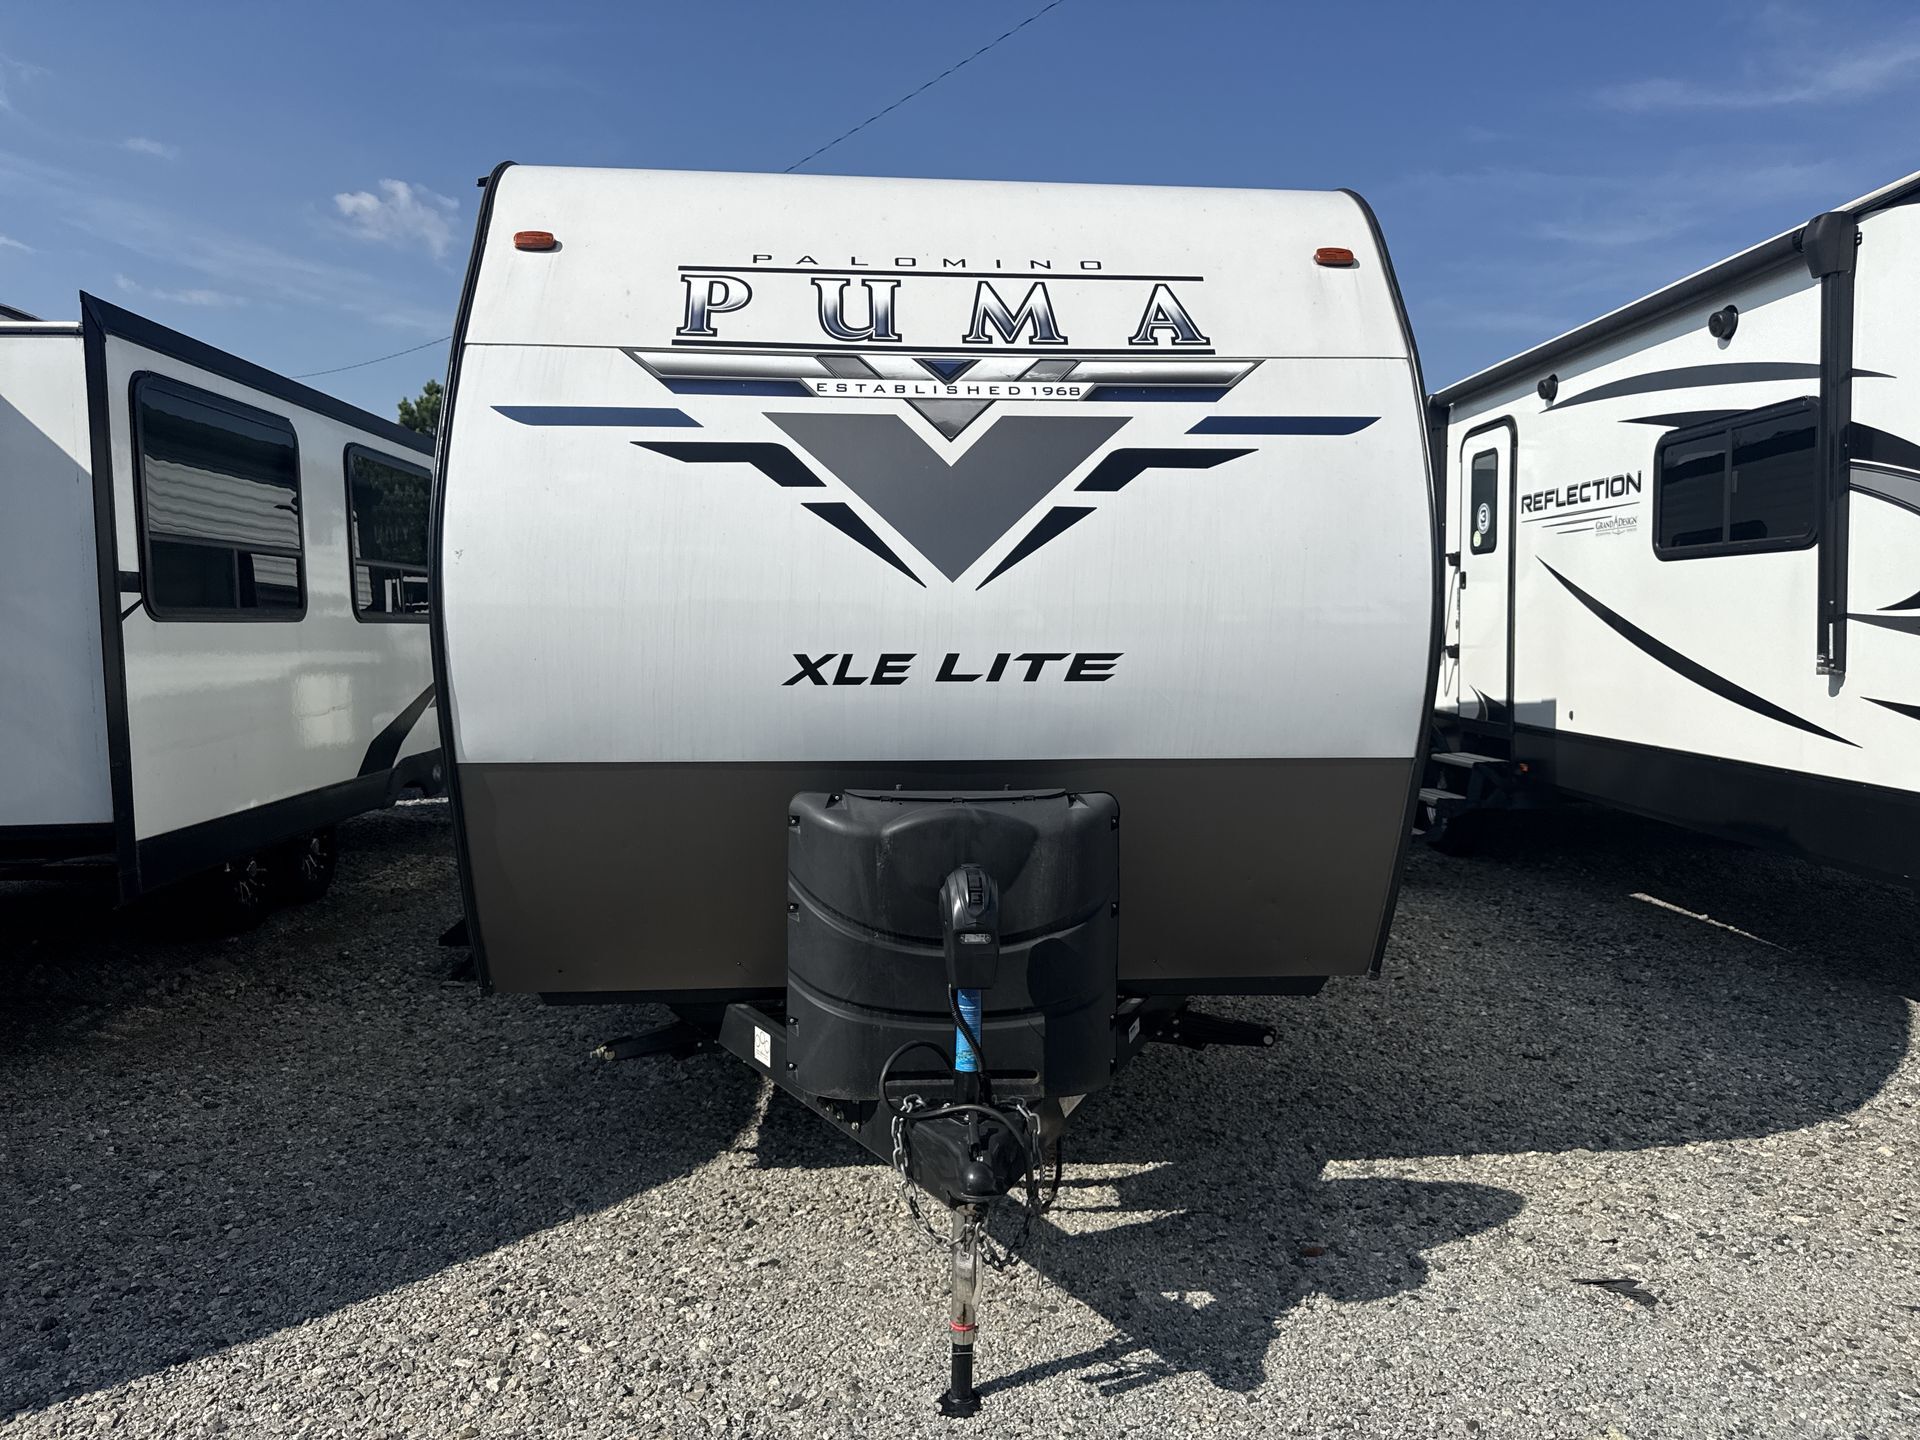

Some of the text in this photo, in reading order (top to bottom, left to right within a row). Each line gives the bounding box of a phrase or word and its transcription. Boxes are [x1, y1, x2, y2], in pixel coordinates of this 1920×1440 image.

[752, 254, 1102, 270] PALOMINO
[676, 274, 1210, 346] PUMA
[816, 382, 1082, 398] ESTABLISHED 1968
[1521, 470, 1642, 515] REFLECTION
[1480, 509, 1487, 524] 3
[781, 652, 1125, 686] XLE LITE
